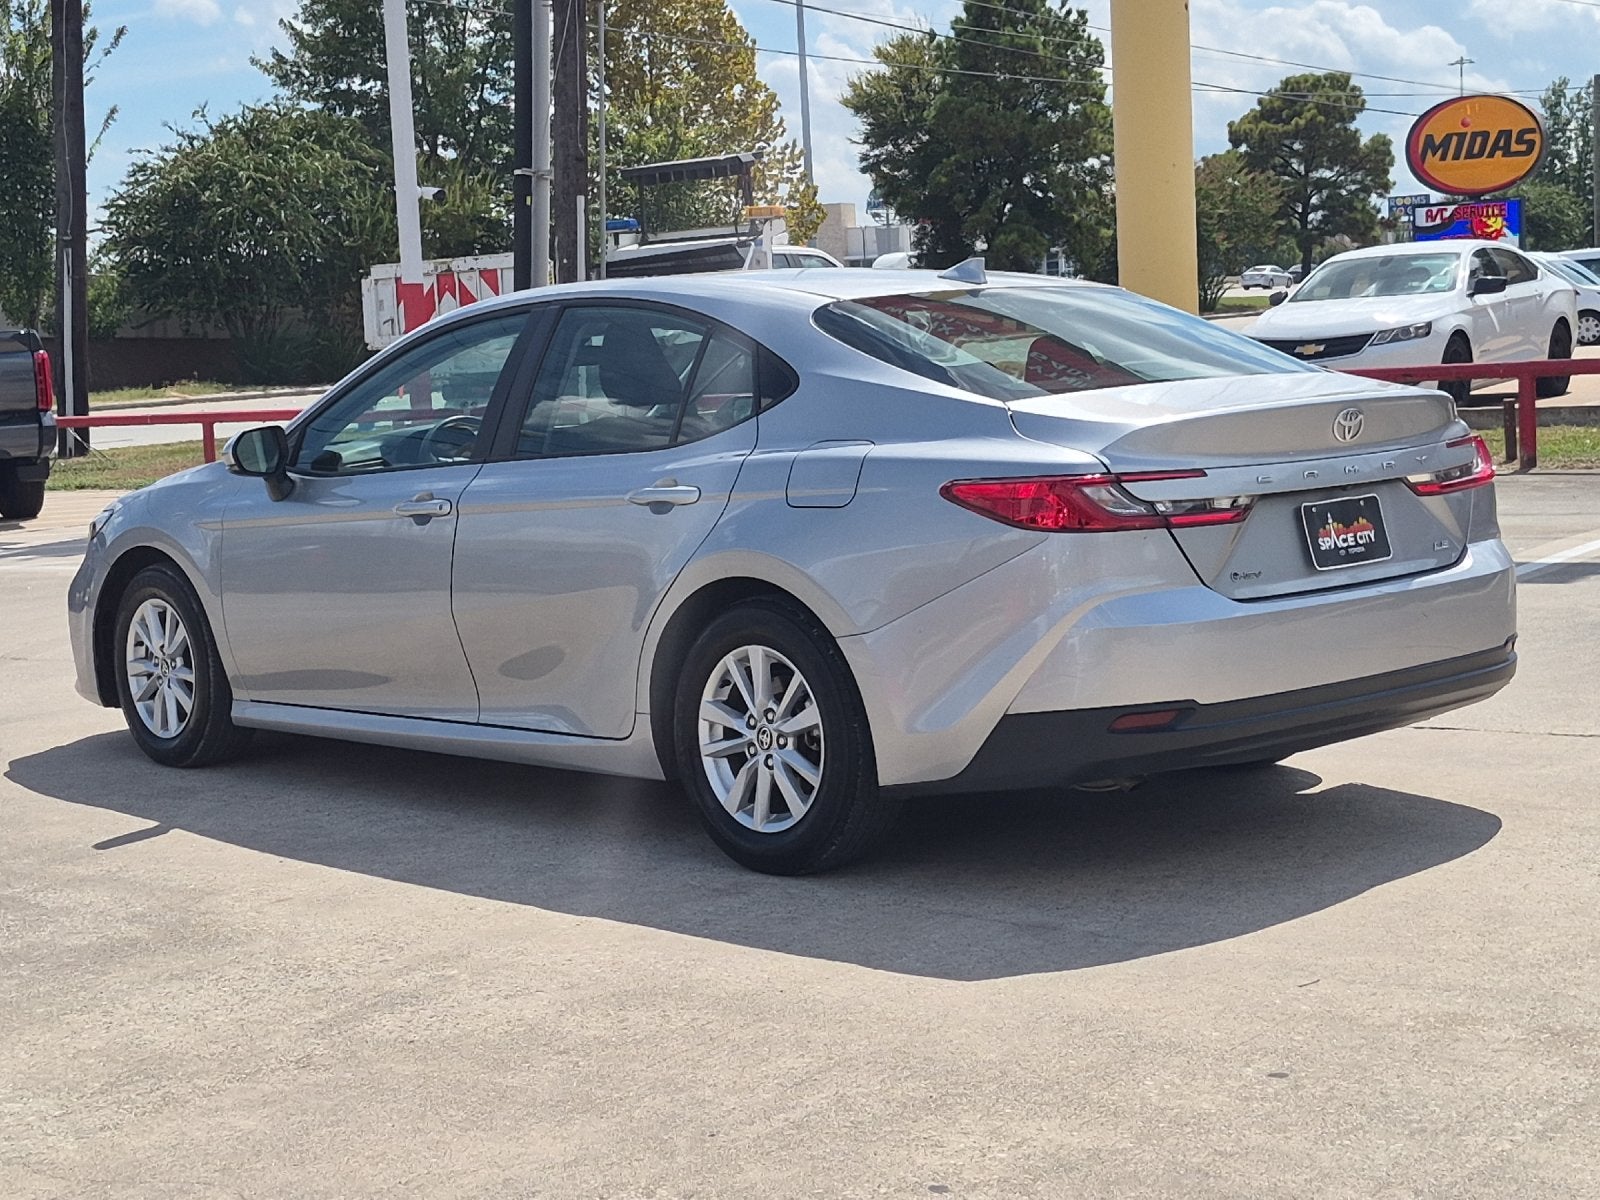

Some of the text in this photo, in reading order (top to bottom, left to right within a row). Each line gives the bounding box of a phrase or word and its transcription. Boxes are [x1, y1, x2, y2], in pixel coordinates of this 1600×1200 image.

[1420, 127, 1537, 166] MIDAS
[1389, 195, 1426, 206] ROOMS
[1425, 203, 1507, 223] A/C SERVICE
[1256, 455, 1428, 484] CAMRY
[1318, 528, 1376, 551] SPACE CITY
